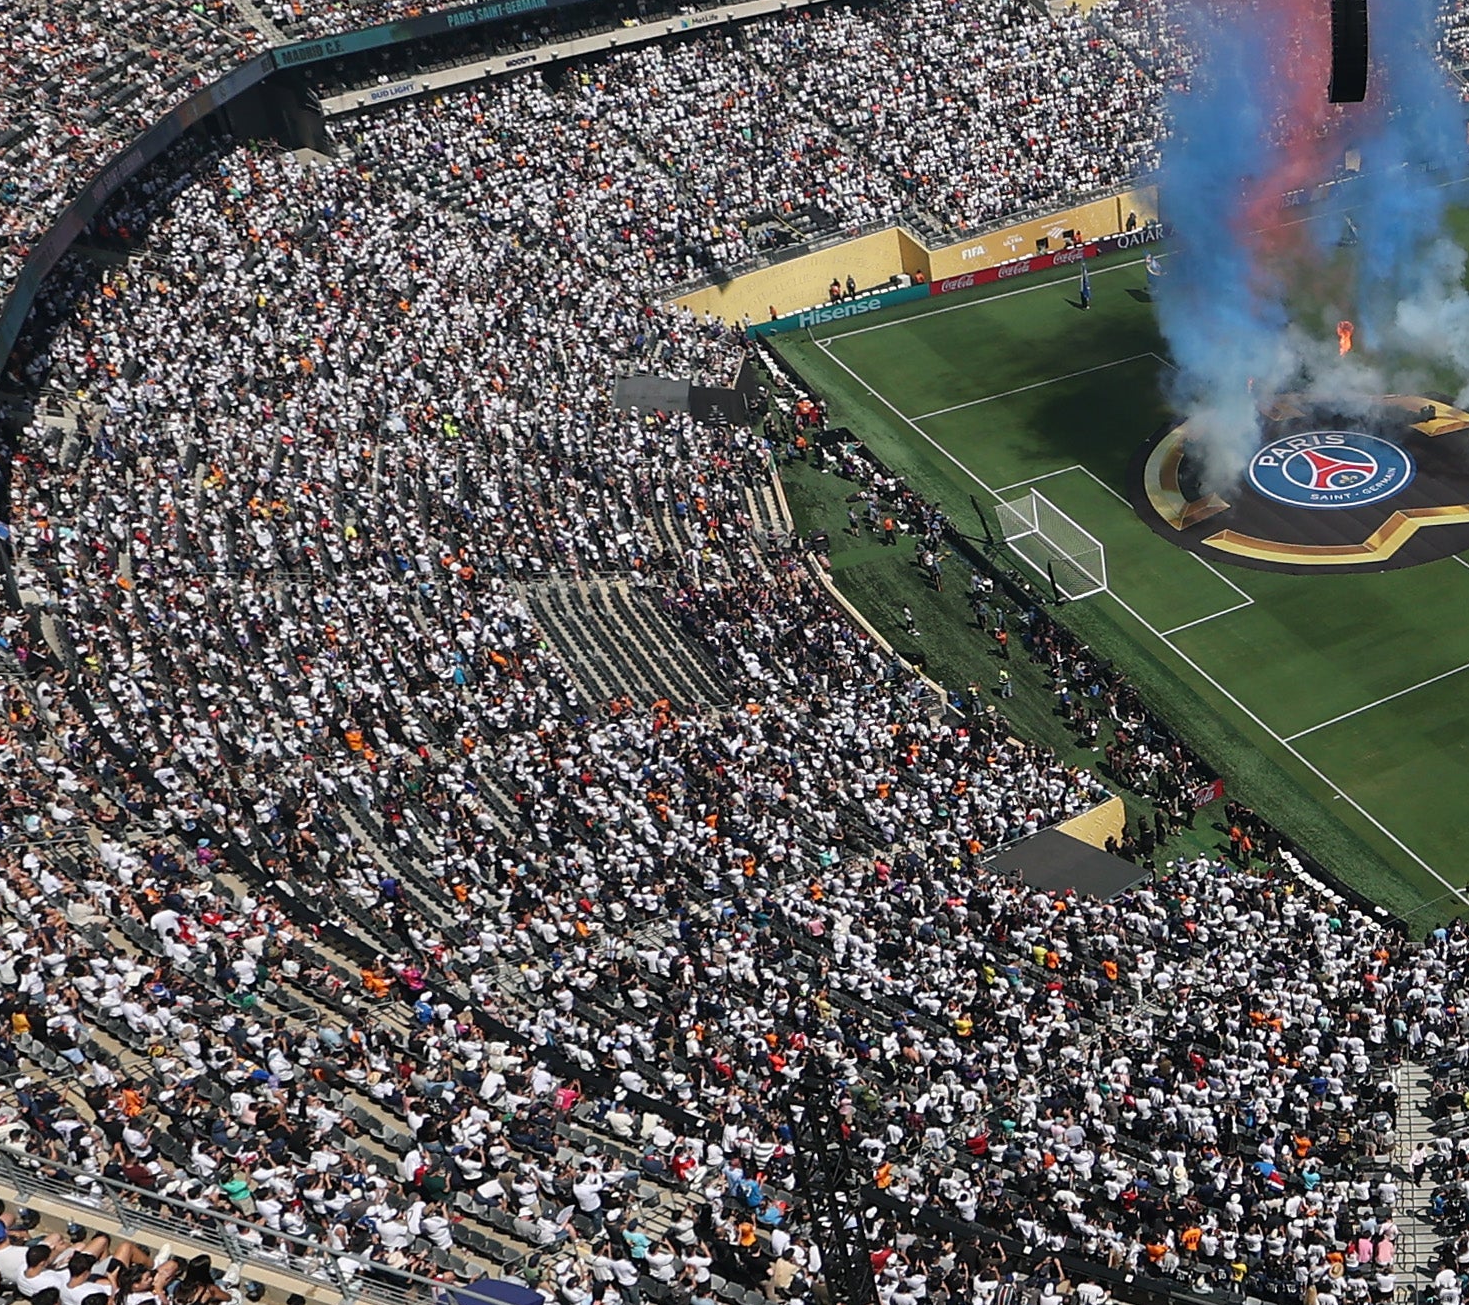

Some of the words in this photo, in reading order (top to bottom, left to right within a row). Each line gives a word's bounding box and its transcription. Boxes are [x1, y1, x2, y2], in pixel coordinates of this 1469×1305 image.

[1117, 226, 1164, 249] QATAR
[962, 246, 986, 261] FIFA
[1052, 248, 1085, 265] Coca-Cola
[997, 261, 1030, 279] Coca-Cola
[941, 274, 975, 293] Coca-Cola
[799, 296, 881, 328] Hisense
[1259, 432, 1345, 467] PARIS
[1310, 492, 1353, 502] SAINT
[1362, 467, 1398, 496] GERMAIN
